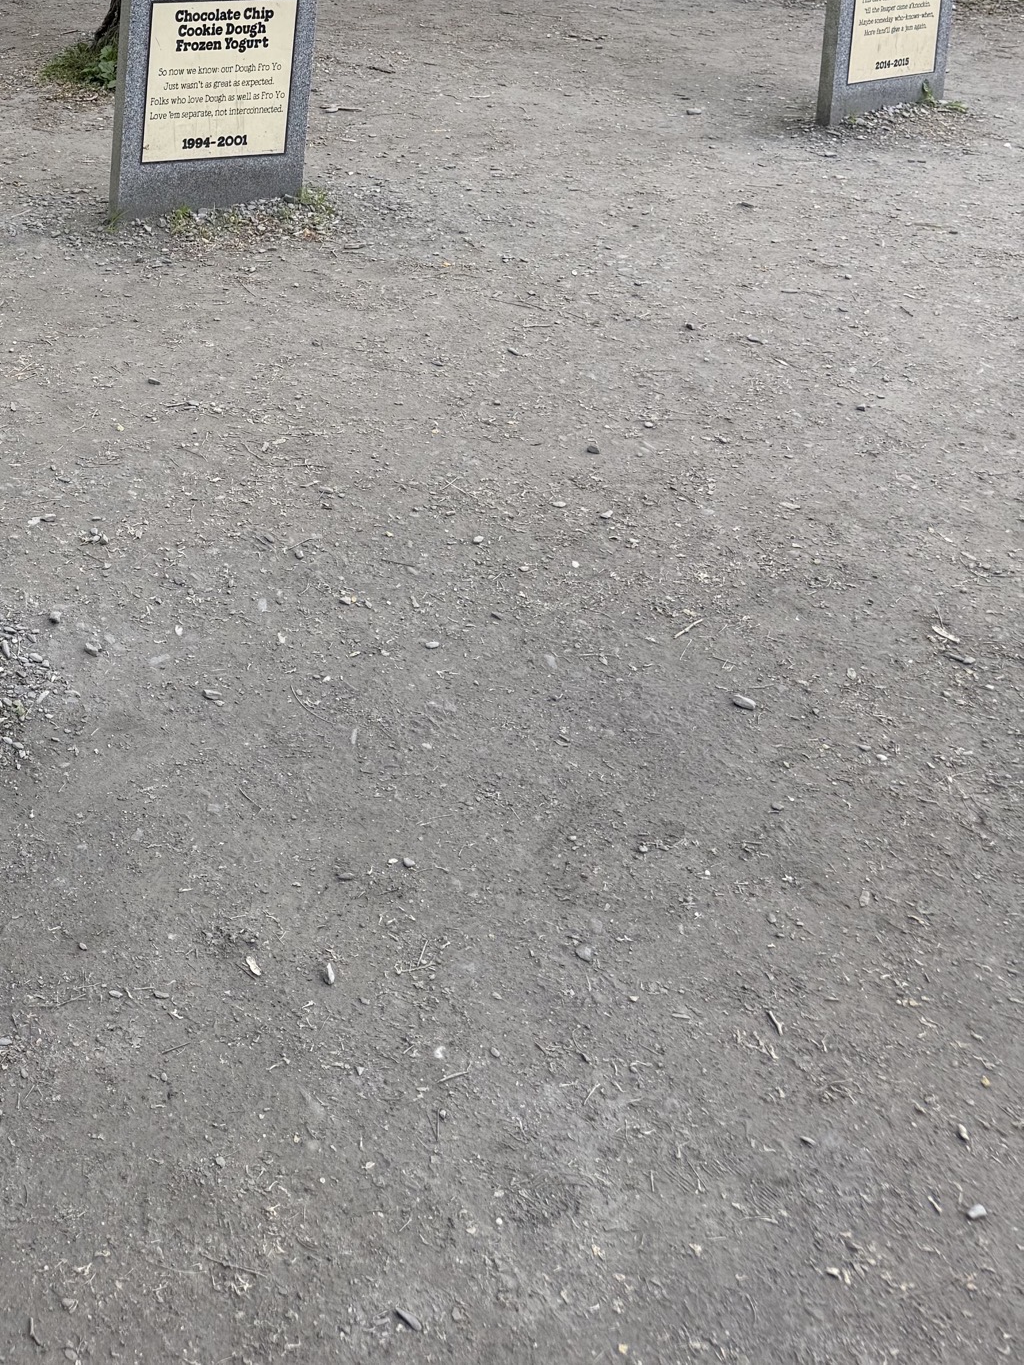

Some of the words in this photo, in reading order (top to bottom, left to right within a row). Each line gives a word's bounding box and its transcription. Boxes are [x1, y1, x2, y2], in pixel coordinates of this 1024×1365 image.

[175, 9, 241, 22] Chocolate
[244, 7, 274, 21] Chip
[178, 24, 223, 36] Cookie
[226, 22, 266, 37] Dough
[176, 39, 222, 51] Frozen
[225, 37, 269, 53] Yogurt
[159, 68, 167, 76] So
[169, 67, 184, 76] now
[198, 65, 219, 74] know:
[221, 65, 233, 73] our
[235, 64, 256, 73] Dough
[258, 63, 270, 71] Fro
[272, 62, 281, 70] Yo
[875, 57, 909, 70] 2014-2015
[164, 82, 179, 90] Just
[181, 80, 203, 89] wasn't
[213, 79, 231, 89] great
[242, 77, 274, 87] expected.
[150, 97, 169, 106] Folks
[171, 96, 186, 104] who
[188, 95, 203, 103] love
[205, 94, 226, 103] Dough
[237, 93, 251, 101] well
[261, 91, 273, 99] Fro
[275, 91, 285, 99] Yo
[150, 112, 167, 120] Love
[169, 111, 180, 119] 'em
[182, 109, 213, 120] separate,
[215, 108, 227, 117] not
[229, 105, 283, 115] interconnected.
[182, 135, 247, 149] 1994-2001
